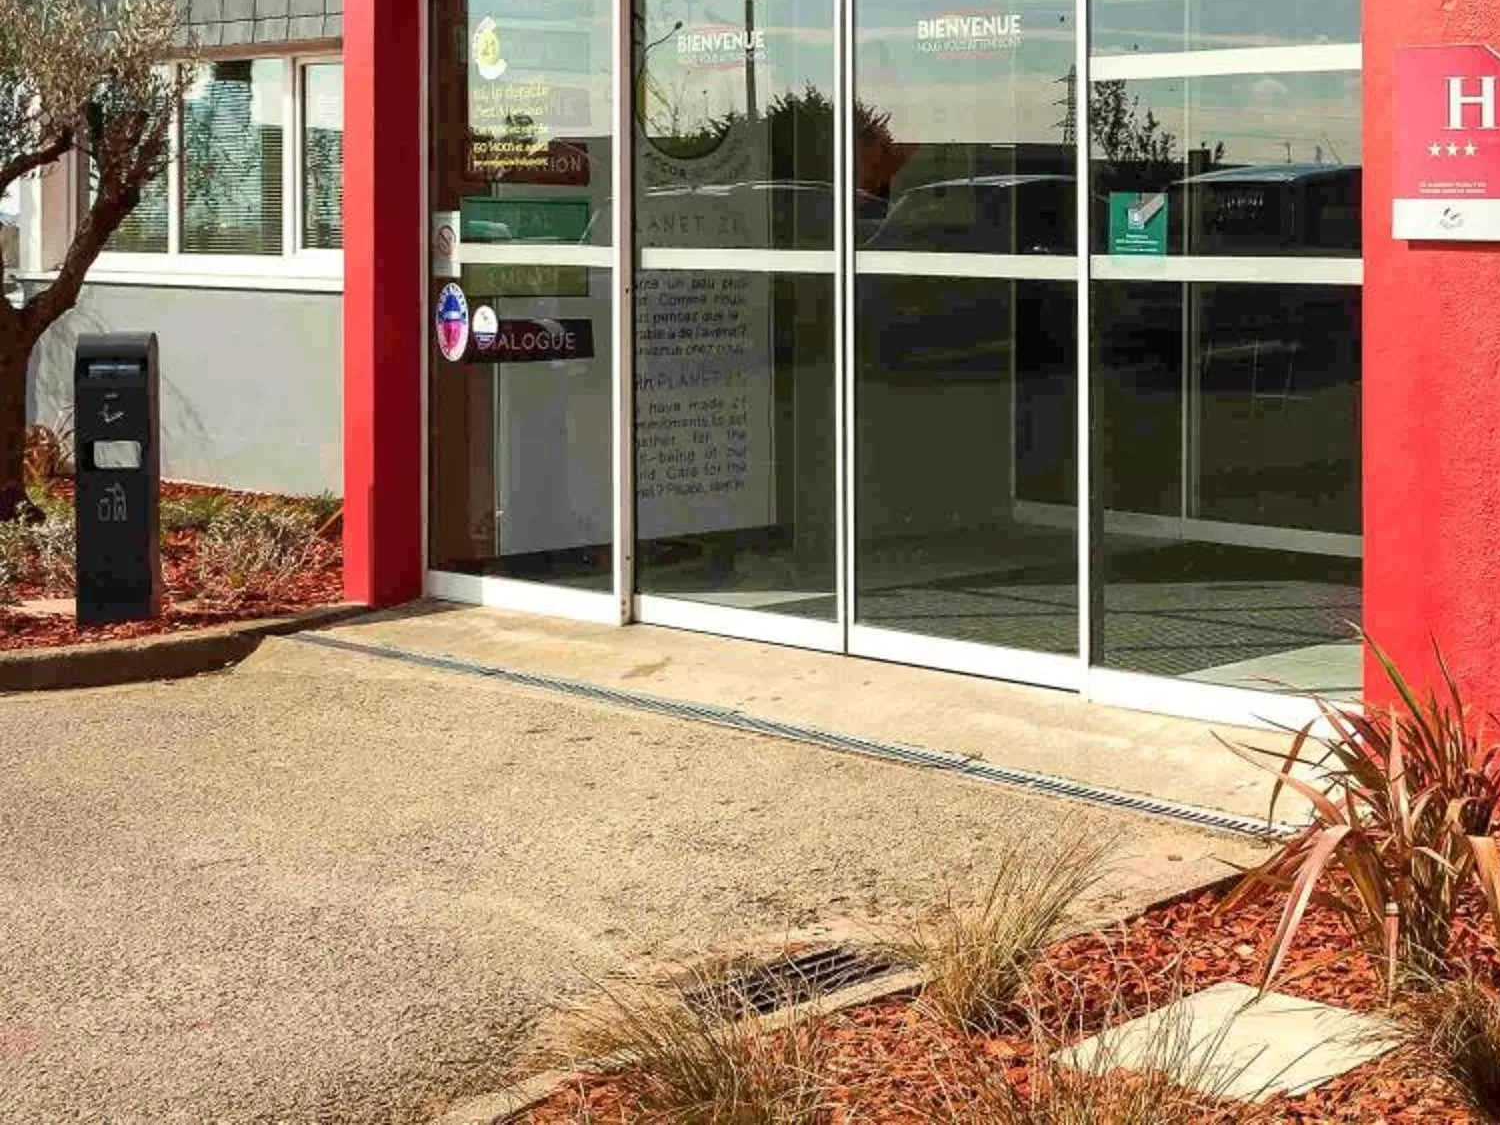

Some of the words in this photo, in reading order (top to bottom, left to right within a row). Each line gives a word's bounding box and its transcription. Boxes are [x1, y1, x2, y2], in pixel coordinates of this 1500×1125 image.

[916, 14, 1022, 40] BIENVENUE
[676, 30, 766, 54] BIENVENUE
[1442, 75, 1500, 130] H
